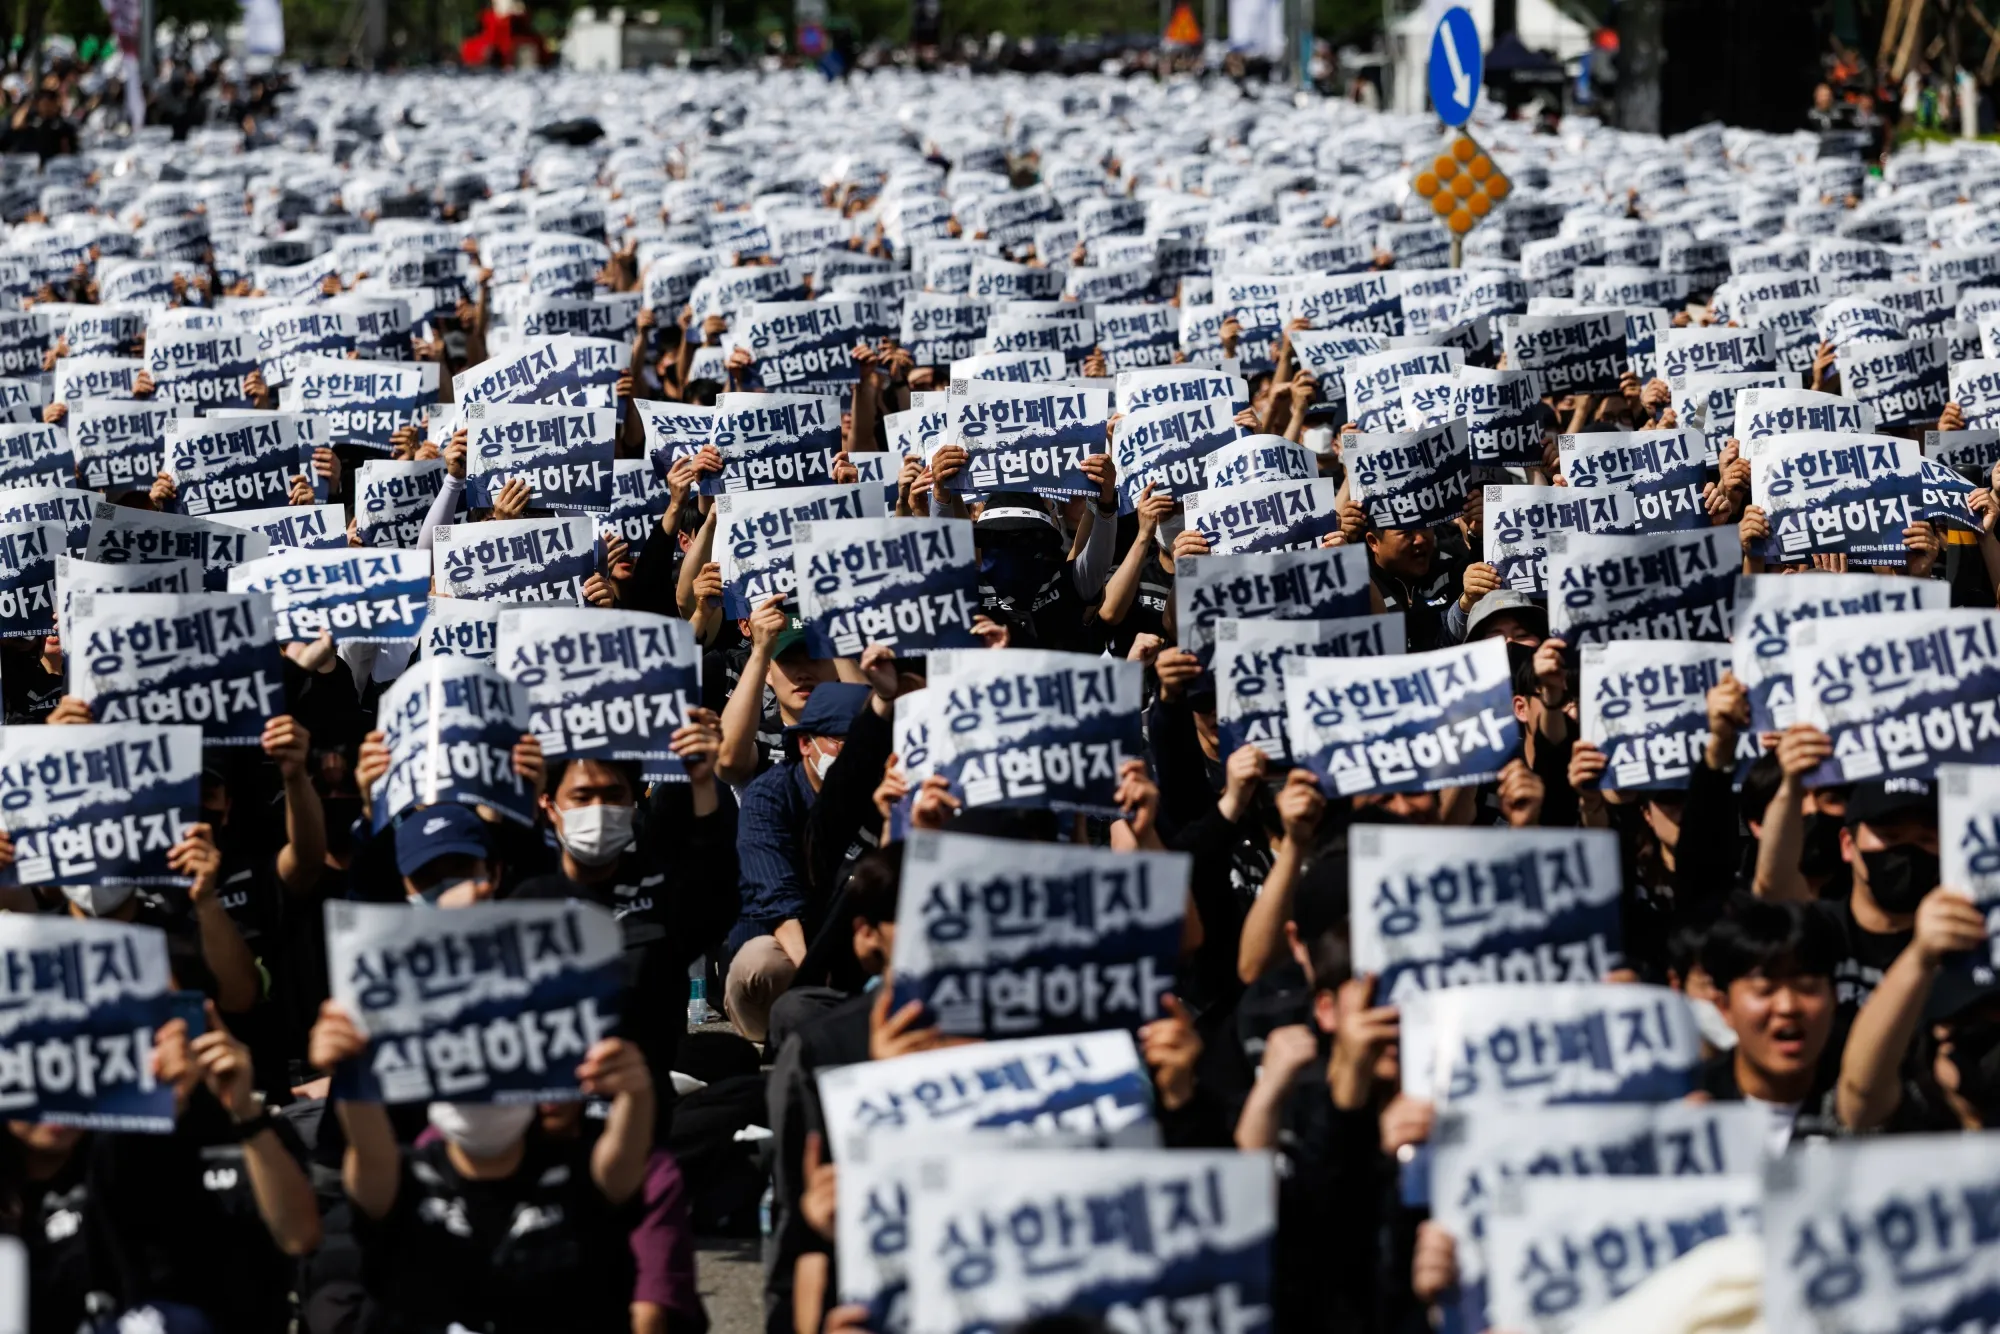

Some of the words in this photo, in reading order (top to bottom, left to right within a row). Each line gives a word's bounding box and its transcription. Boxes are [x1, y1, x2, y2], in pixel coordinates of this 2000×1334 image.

[1299, 279, 1387, 318] 상한폐지
[151, 337, 242, 371] 상한폐지
[258, 314, 343, 350] 상한폐지
[750, 305, 841, 349] 상한폐지
[1514, 311, 1612, 359] 상한폐지
[761, 343, 852, 386] 실현하자
[1664, 334, 1768, 376] 상한폐지
[1850, 343, 1934, 389] 상한폐지
[301, 373, 401, 400] 상한폐지
[1454, 375, 1533, 416] 상한폐지
[1956, 373, 2000, 409] 상한
[477, 412, 597, 458] 상한폐지
[714, 400, 826, 447] 상한폐지
[958, 392, 1087, 438] 상한폐지
[1117, 404, 1214, 466] 상한폐지
[86, 454, 164, 487] 실현하
[173, 419, 289, 470] 상한폐지
[721, 451, 833, 492] 실현하자
[969, 443, 1091, 488] 실현하자
[1354, 427, 1456, 487] 상한폐지
[1569, 434, 1688, 488] 상한폐지
[1763, 441, 1901, 497] 상한폐지
[183, 466, 296, 516] 실현하자
[364, 467, 448, 513] 상한폐
[1033, 486, 1072, 495] 삼성전자노동조합
[1128, 454, 1208, 508] 실현하
[1368, 468, 1472, 529] 실현하자
[1634, 483, 1702, 529] 하자
[252, 510, 327, 549] 폐지
[1195, 483, 1316, 546] 상한폐지
[1494, 495, 1619, 544] 상한폐지
[1777, 495, 1924, 552] 실현하자
[100, 529, 247, 564] 상한폐지
[445, 522, 571, 582] 상한폐지
[808, 525, 955, 594] 상한폐지
[1560, 534, 1720, 609] 상한폐지
[1032, 589, 1060, 612] SELU
[1189, 553, 1345, 628] 상한폐지
[86, 599, 251, 675] 상한폐지
[792, 617, 802, 629] LA
[829, 589, 982, 656] 실현하자
[513, 623, 677, 687] 상한폐지
[1812, 618, 1997, 705] 상한폐지
[944, 665, 1118, 734] 상한폐지
[1305, 651, 1477, 726] 상한폐지
[1597, 658, 1733, 719] 상한폐
[529, 688, 690, 757] 실현하자
[0, 732, 172, 812] 상한폐지
[959, 739, 1124, 808] 실현하자
[1328, 707, 1515, 797] 실현하자
[14, 807, 189, 885] 실현하자
[223, 891, 247, 908] LU
[921, 860, 1151, 944] 상한폐지
[1371, 839, 1599, 939] 상한폐지
[350, 910, 584, 1010] 상한폐지
[930, 956, 1176, 1035] 실현하자
[374, 996, 622, 1100] 실현하자
[941, 1168, 1226, 1291] 상한폐지
